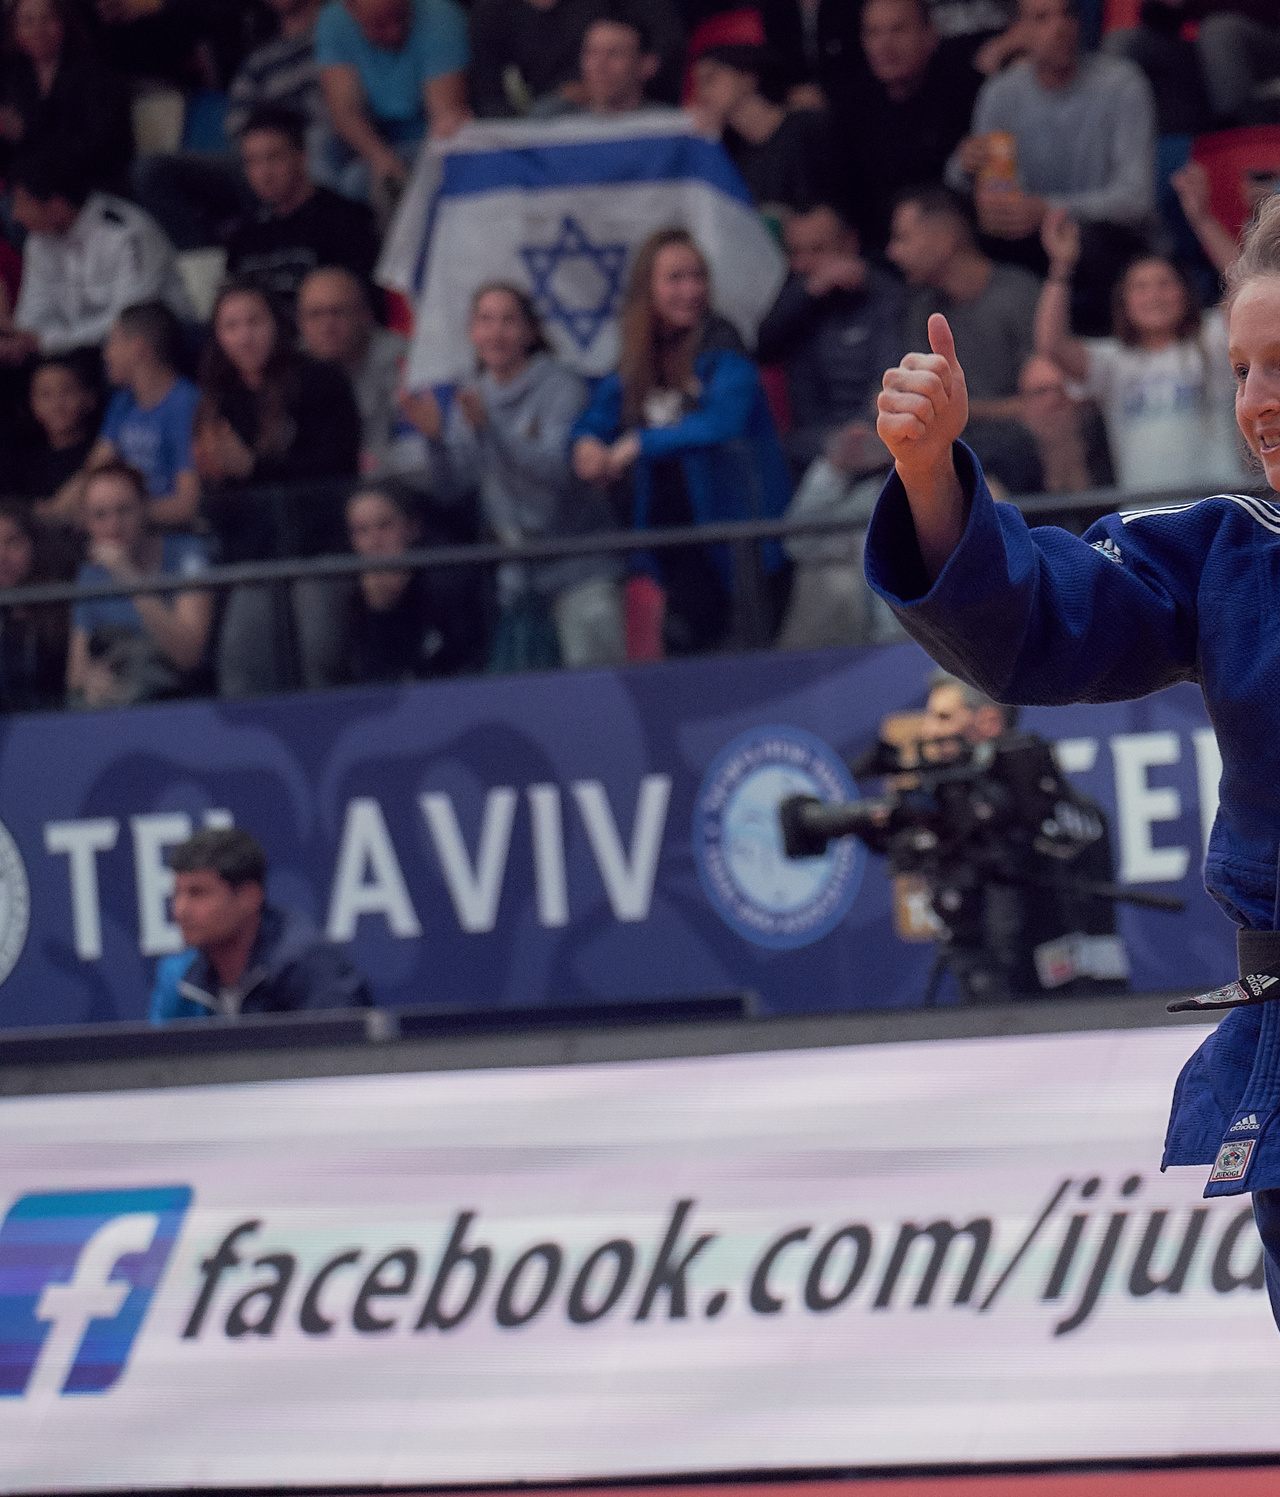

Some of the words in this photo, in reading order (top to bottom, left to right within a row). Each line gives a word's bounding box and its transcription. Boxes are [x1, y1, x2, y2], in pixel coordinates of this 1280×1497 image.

[44, 808, 236, 960] TE
[327, 776, 671, 941] AVIV
[1229, 1123, 1260, 1132] adidas
